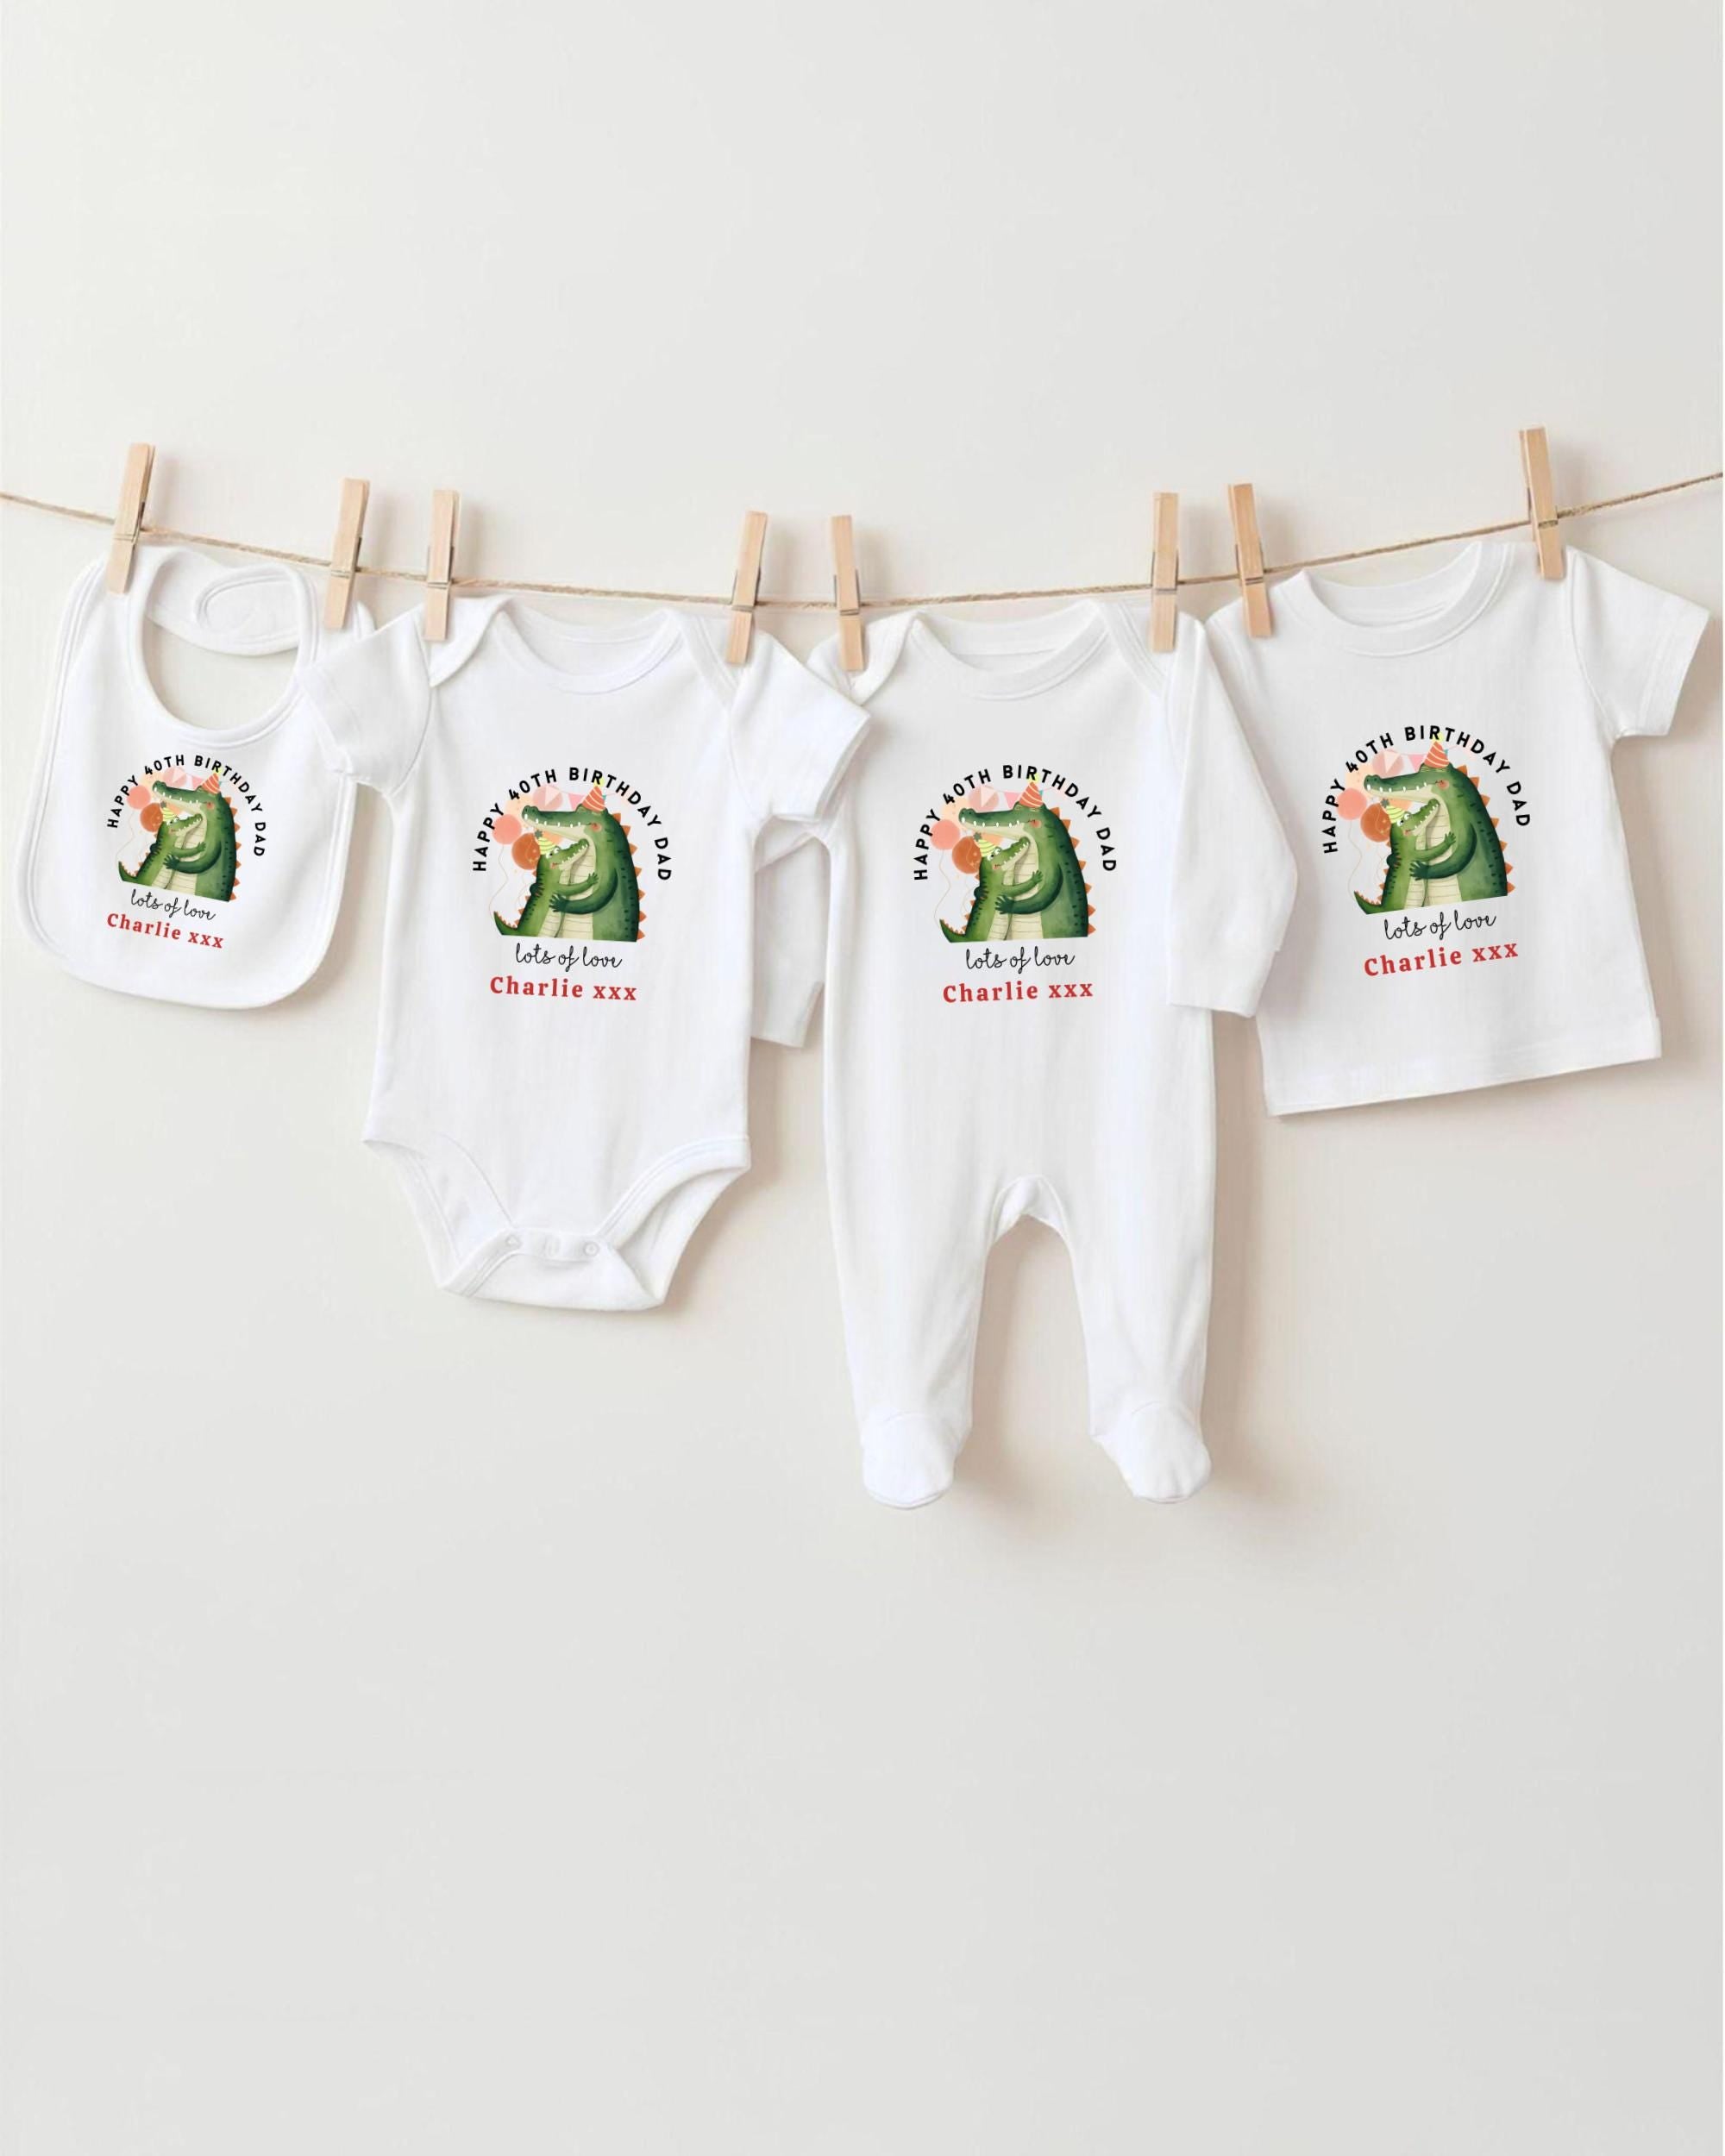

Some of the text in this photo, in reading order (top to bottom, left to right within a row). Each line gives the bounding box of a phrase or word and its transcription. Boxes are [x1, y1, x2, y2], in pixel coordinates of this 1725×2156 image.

[106, 754, 267, 856] HAPPY 40TH BIRTHDAY DAD
[1321, 724, 1531, 854] HAPPY 40TH BIRTHDAY DAD
[472, 767, 672, 881] HAPPY 40TH BIRTHDAY DAD
[913, 764, 1117, 881] HAPPY 40TH BIRTHDAY DAD
[130, 888, 216, 921] lots of love
[107, 913, 224, 949] Charlie xxx
[1383, 909, 1497, 941] lots of love
[515, 942, 623, 973] lots of love
[965, 945, 1076, 975] lots of love
[1364, 943, 1519, 977] Charlie xxx
[490, 975, 637, 1001] Charlie xxx
[943, 981, 1094, 1003] Charlie xxx
